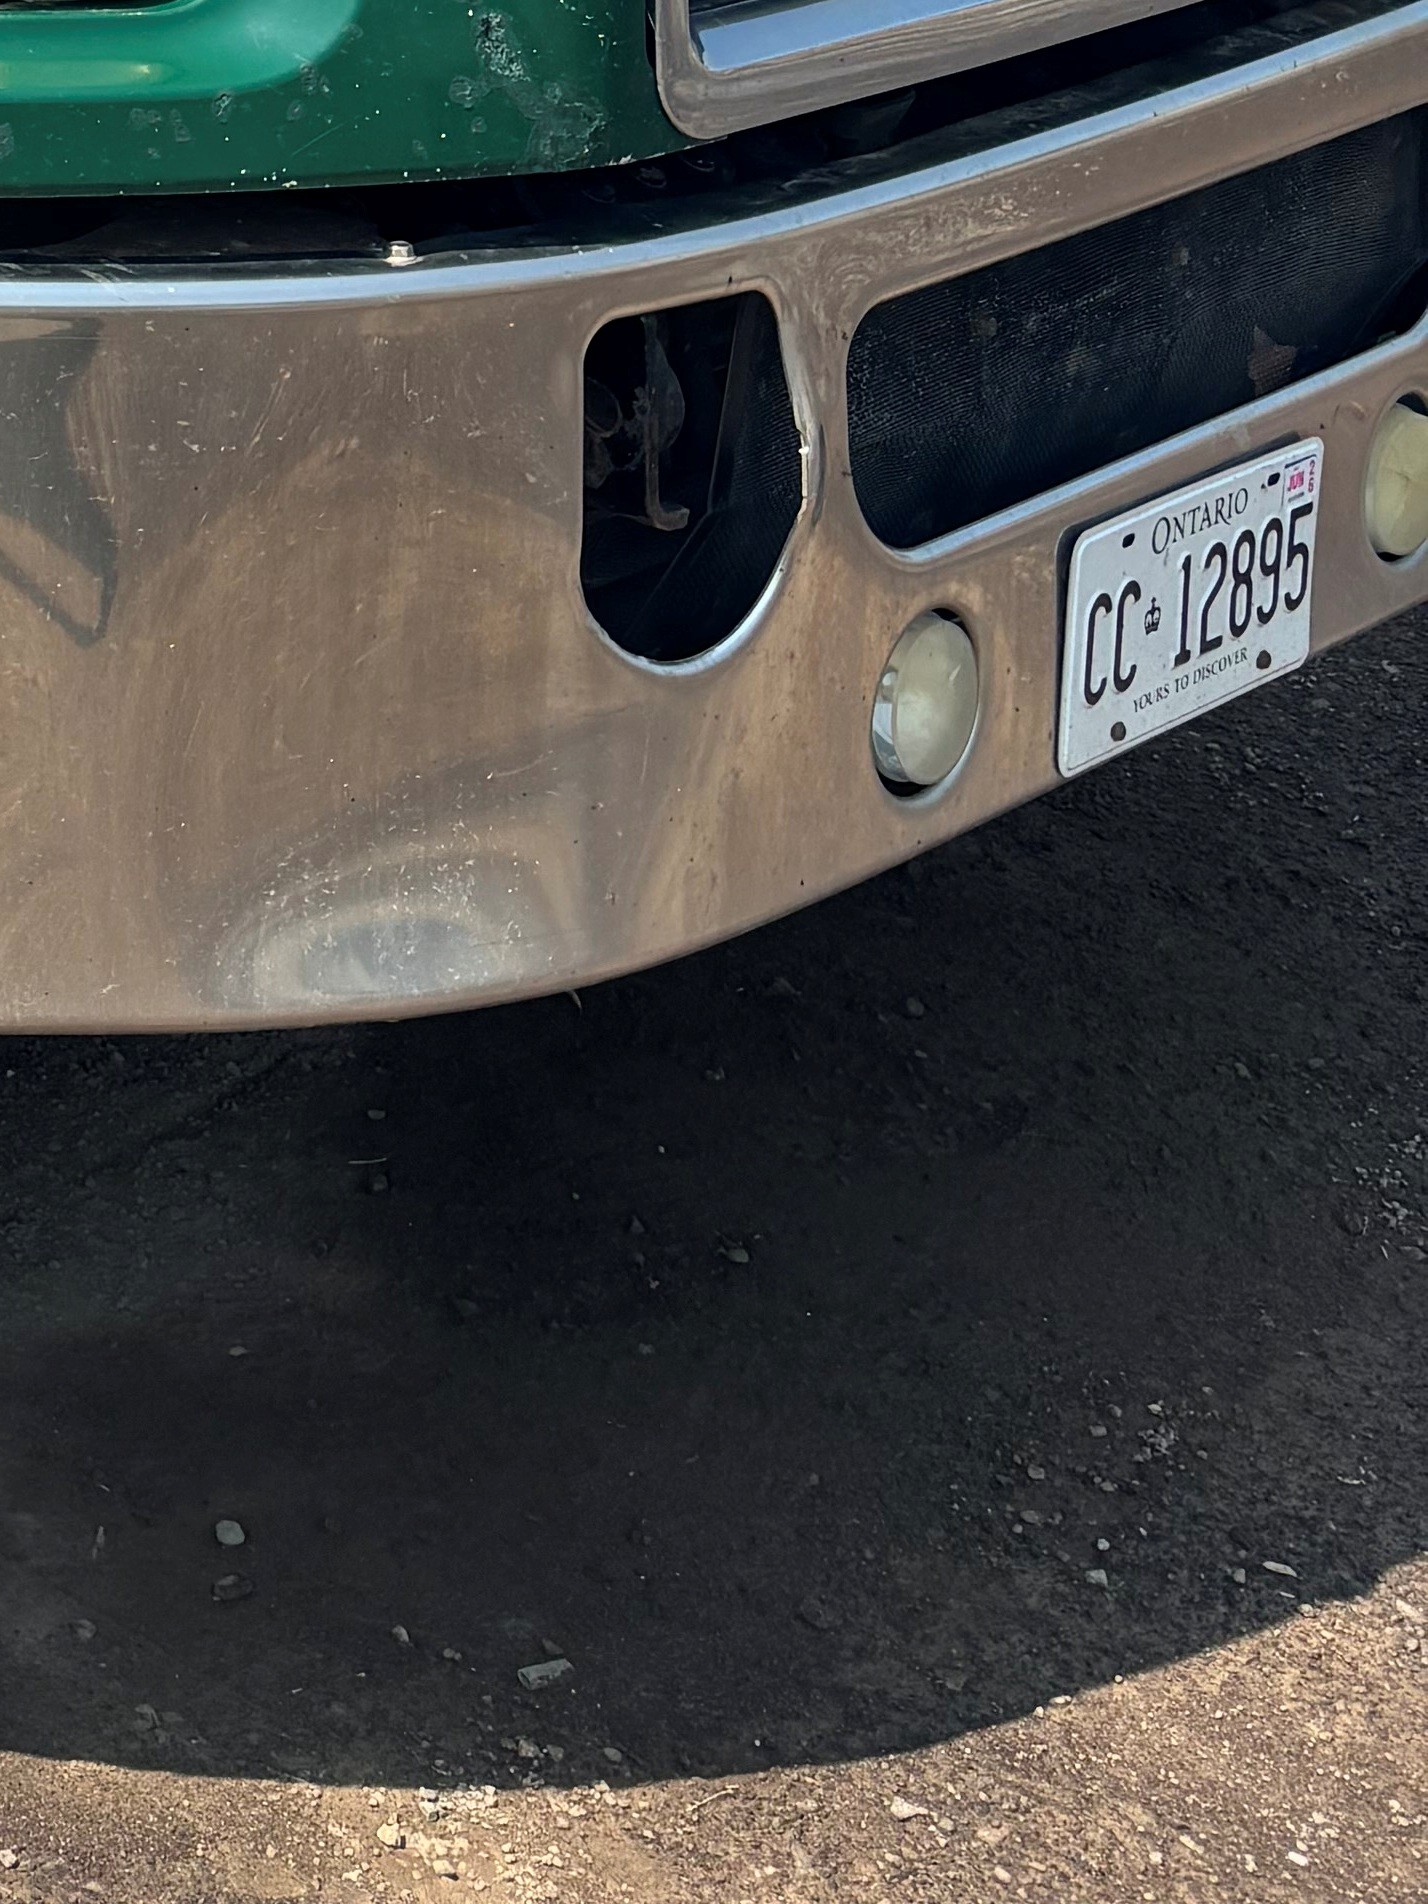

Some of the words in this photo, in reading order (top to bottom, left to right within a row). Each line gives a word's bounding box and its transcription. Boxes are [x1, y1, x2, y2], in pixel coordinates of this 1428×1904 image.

[1151, 487, 1249, 555] ONTARIO
[1084, 579, 1142, 706] CC
[1173, 501, 1314, 670] 12895
[1132, 683, 1170, 714] YOURS
[1174, 672, 1190, 694] TO
[1192, 647, 1248, 685] DISCOVER
